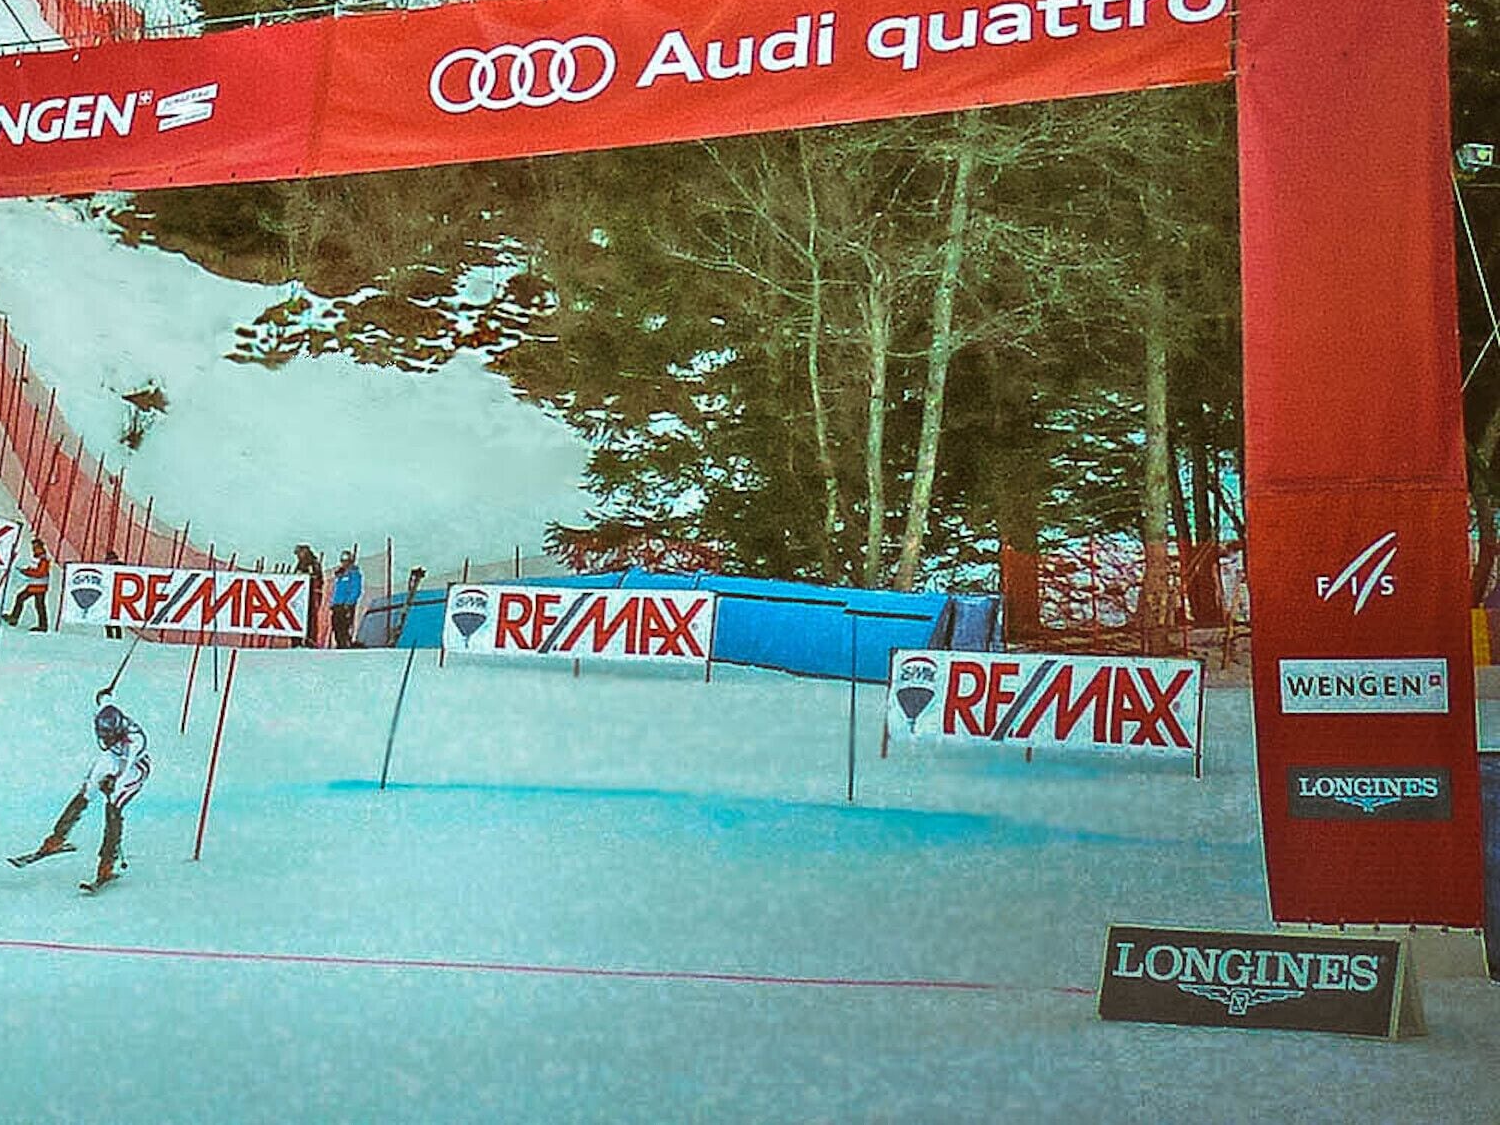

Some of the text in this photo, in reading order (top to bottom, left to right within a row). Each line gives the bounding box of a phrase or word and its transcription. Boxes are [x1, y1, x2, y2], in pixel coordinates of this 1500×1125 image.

[637, 14, 835, 88] Audi
[111, 571, 306, 631] RE/MAX
[495, 592, 708, 657] RE/MAX
[943, 660, 1194, 749] RE/MAX
[1286, 674, 1422, 697] WENGEN
[1298, 776, 1439, 797] LONGINES
[1112, 941, 1379, 992] LONGINES
